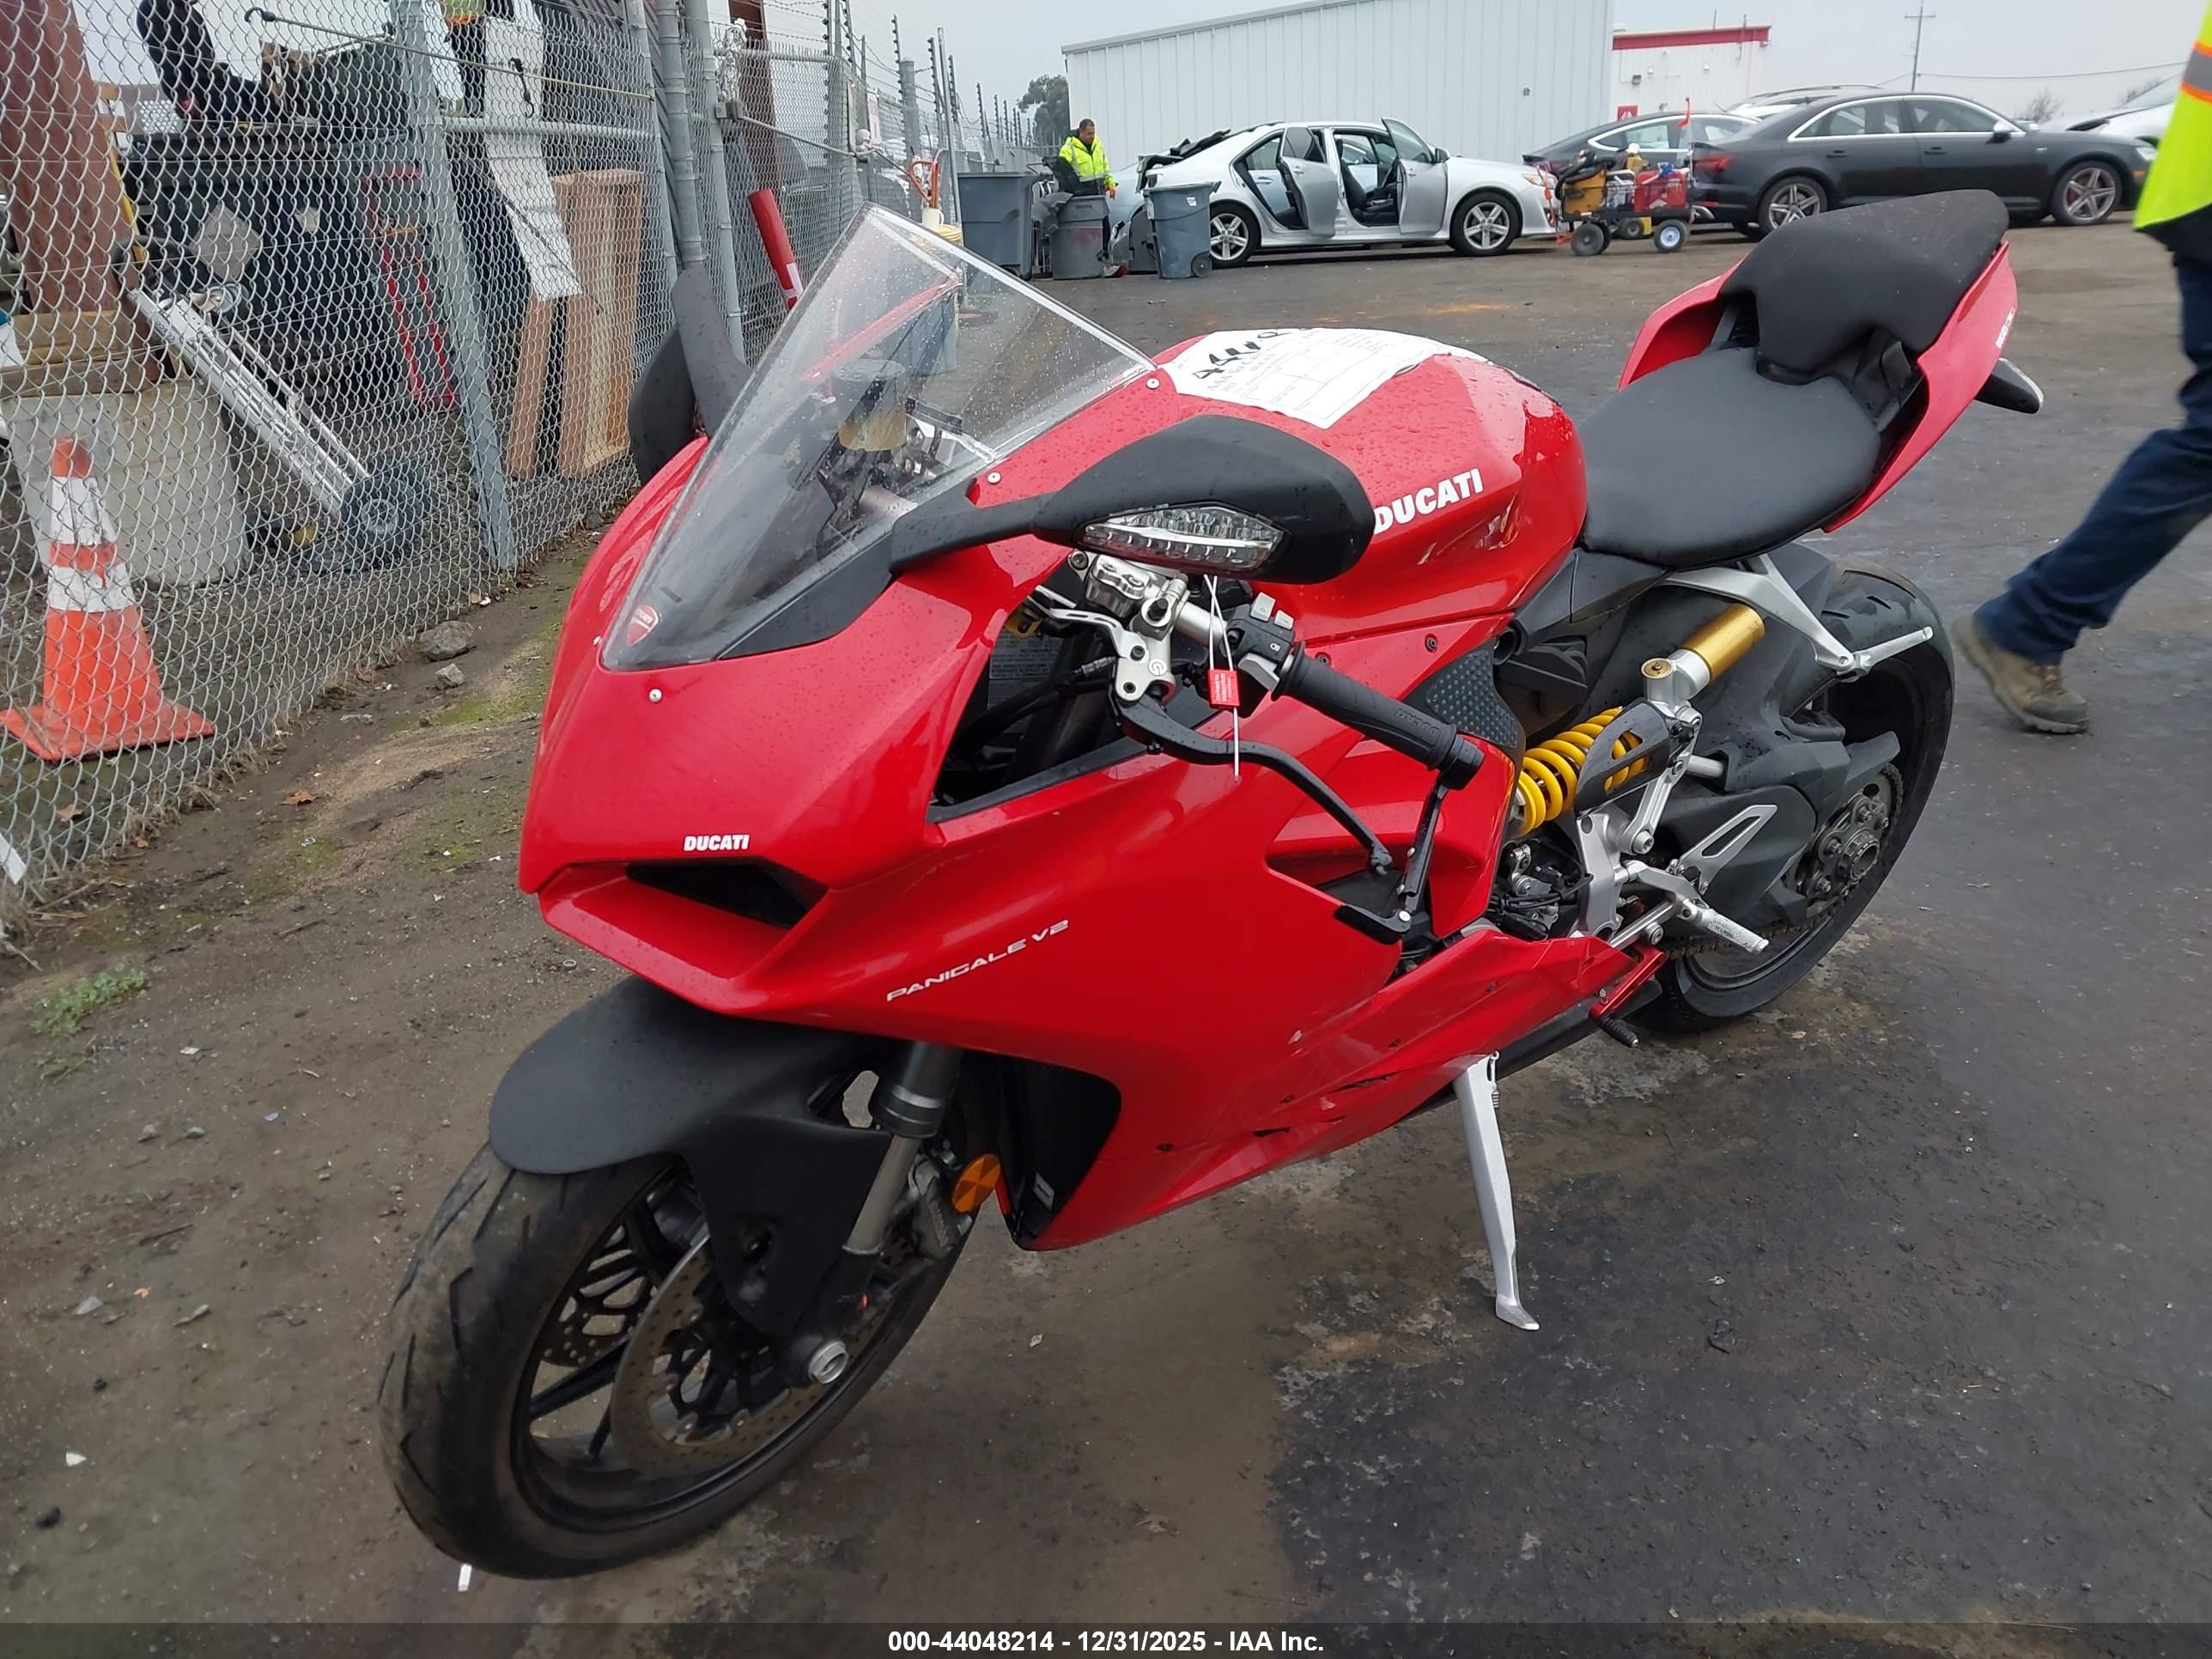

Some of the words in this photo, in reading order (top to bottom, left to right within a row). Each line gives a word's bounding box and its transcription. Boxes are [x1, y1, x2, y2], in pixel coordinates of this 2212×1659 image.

[1374, 468, 1484, 534] DUCATI
[684, 834, 750, 852] DUCATI
[886, 939, 1027, 1002] PANIGALE
[1031, 920, 1069, 941] V2
